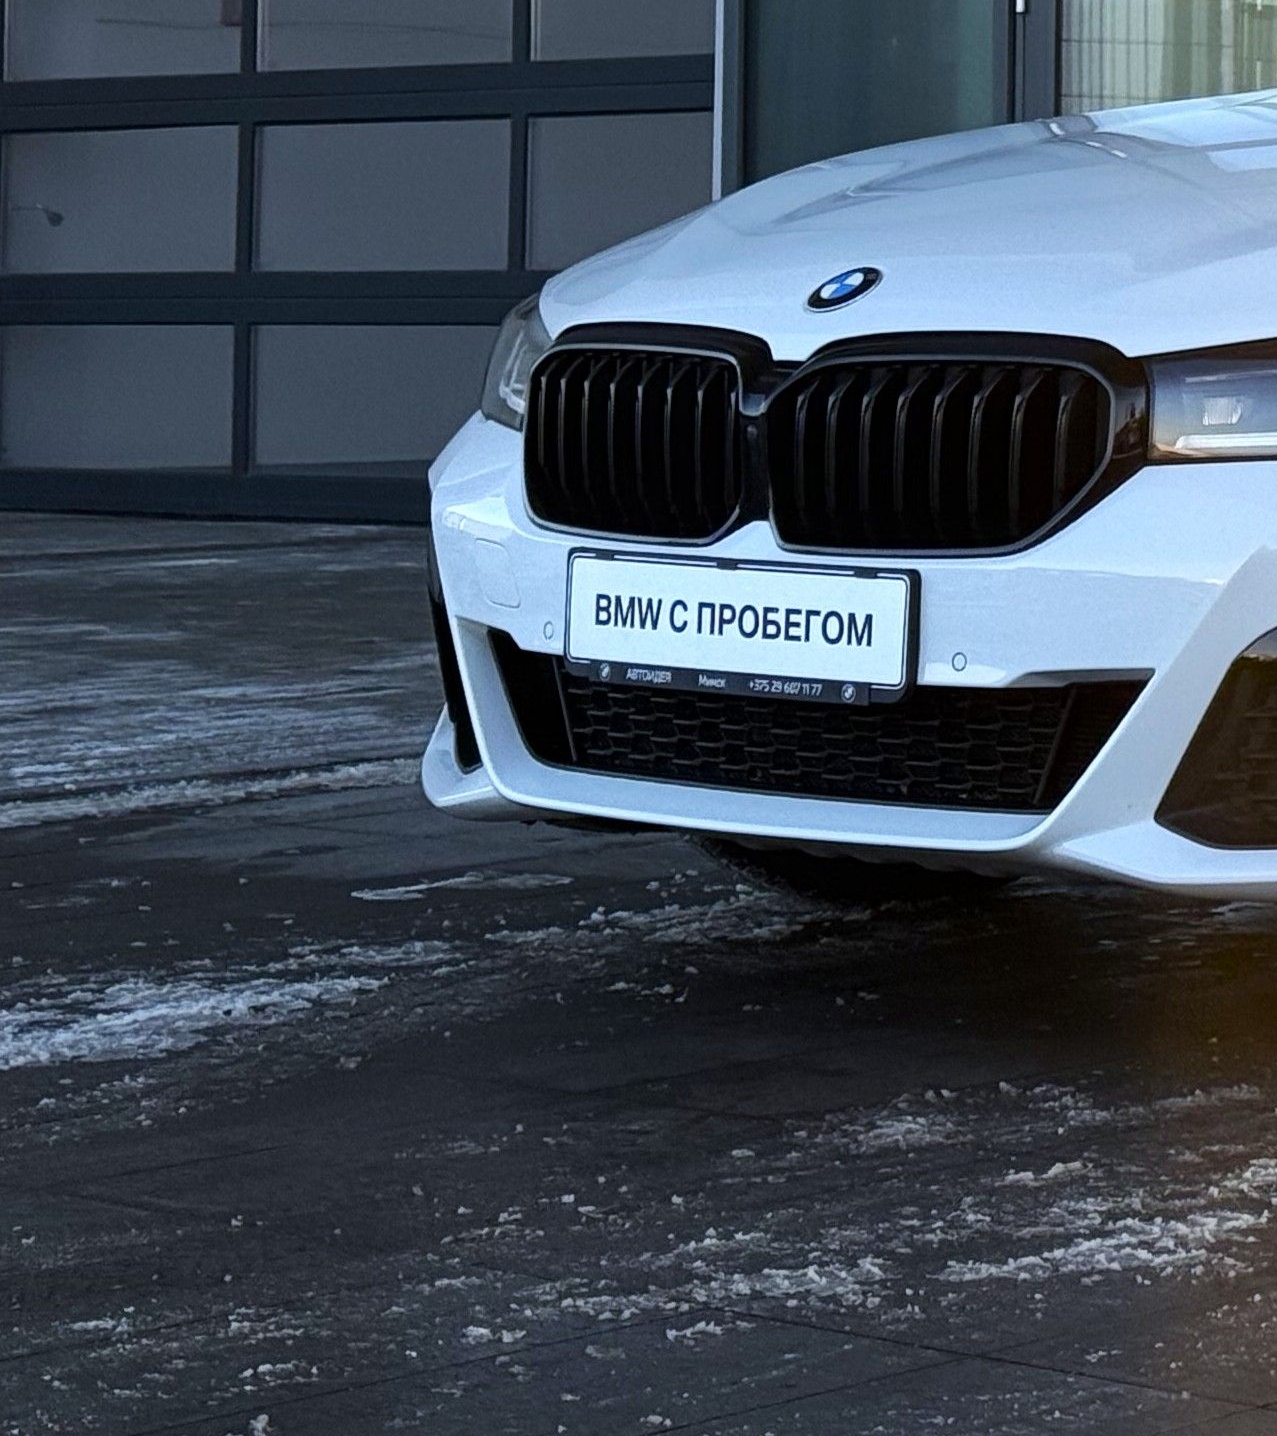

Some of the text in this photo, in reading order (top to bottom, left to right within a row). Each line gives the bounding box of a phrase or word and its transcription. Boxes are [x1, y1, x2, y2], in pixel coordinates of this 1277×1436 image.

[595, 593, 874, 647] BMW С ПРОБЕГОМ
[626, 668, 672, 684] АВТОИДЕЯ
